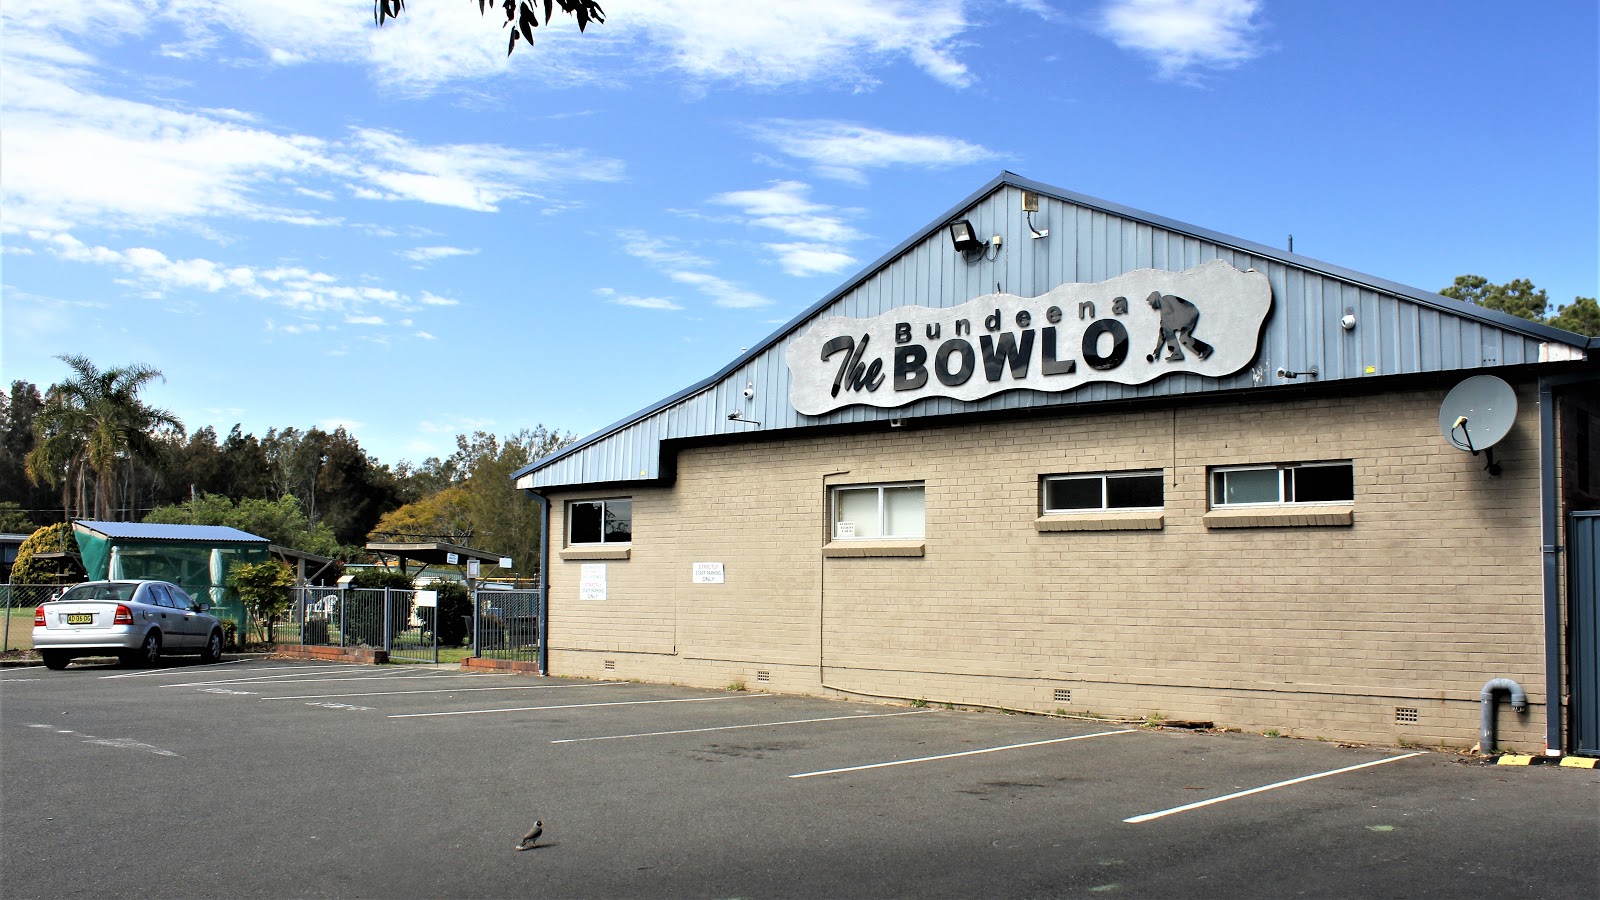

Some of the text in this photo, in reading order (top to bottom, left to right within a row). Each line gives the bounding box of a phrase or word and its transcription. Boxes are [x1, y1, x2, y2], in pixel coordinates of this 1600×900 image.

[894, 296, 1129, 343] Bundeena
[820, 318, 1130, 398] The BOWLO
